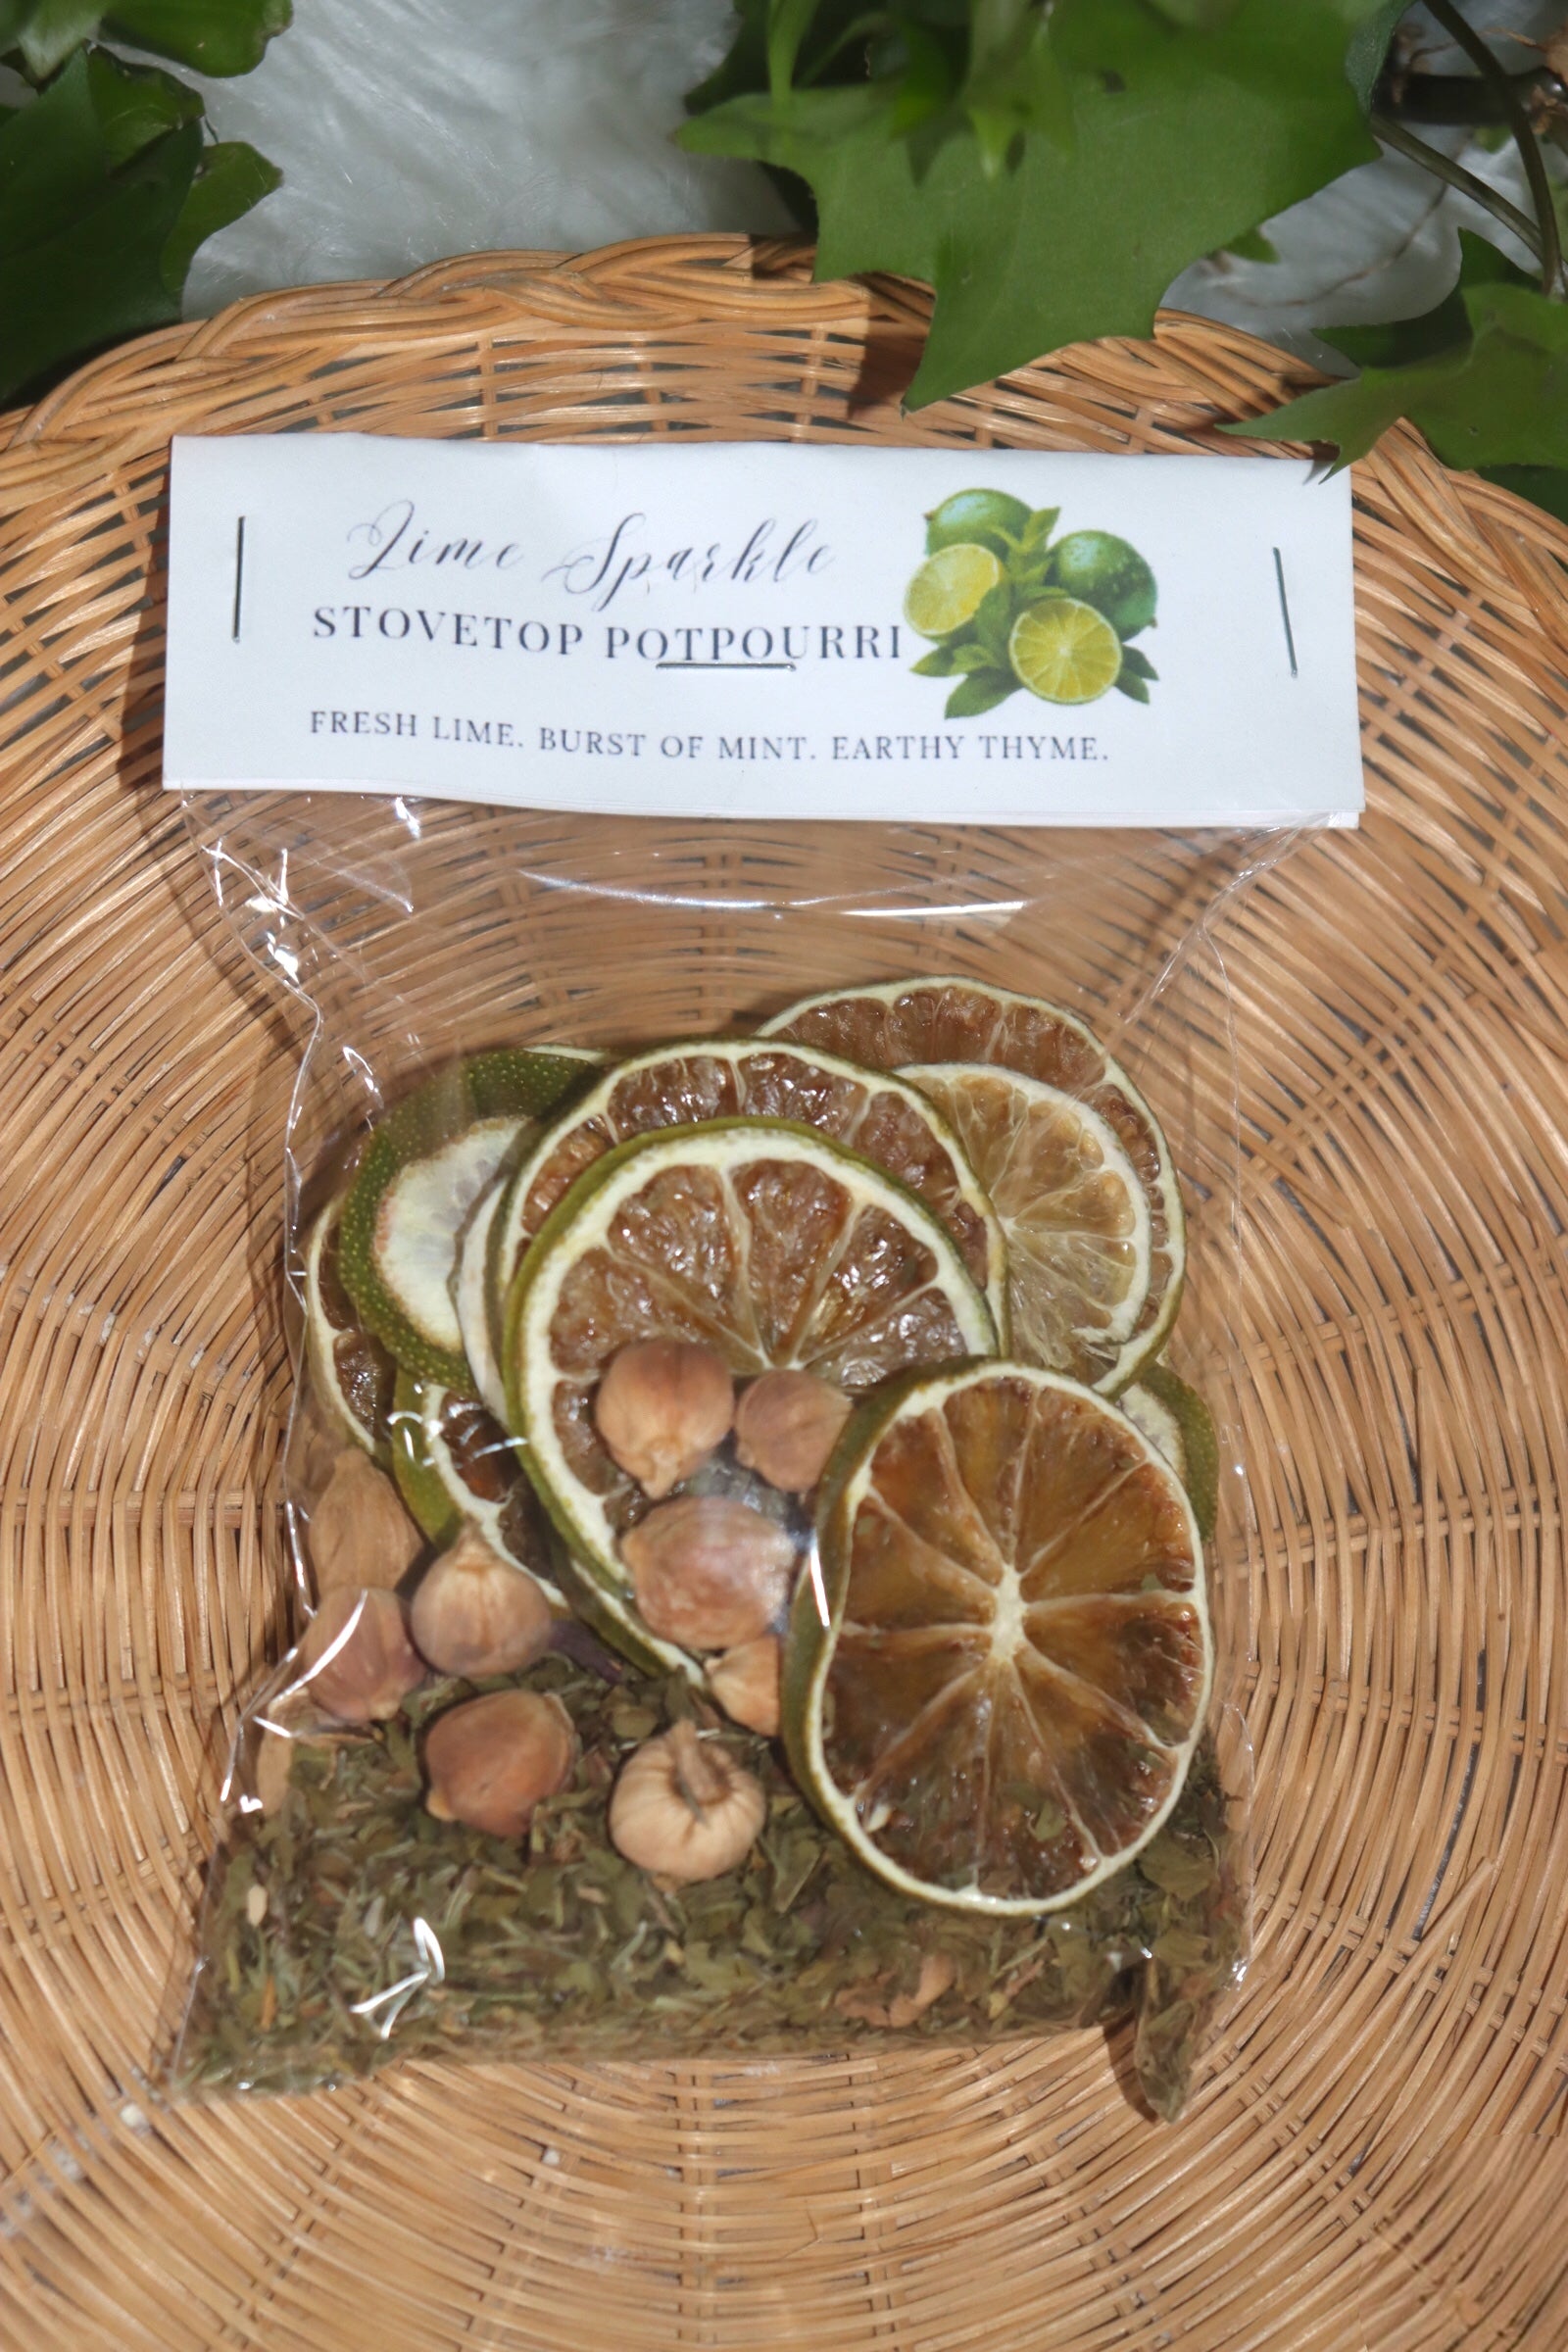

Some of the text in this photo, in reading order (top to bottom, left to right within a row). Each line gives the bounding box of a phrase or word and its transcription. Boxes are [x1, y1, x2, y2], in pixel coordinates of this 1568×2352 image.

[347, 499, 836, 612] Lime Sparkle
[313, 605, 902, 662] STOVETOP POTPOURRI
[310, 710, 1108, 761] FRESH LIME. BURST OF MINT. EARTHY THYME.
